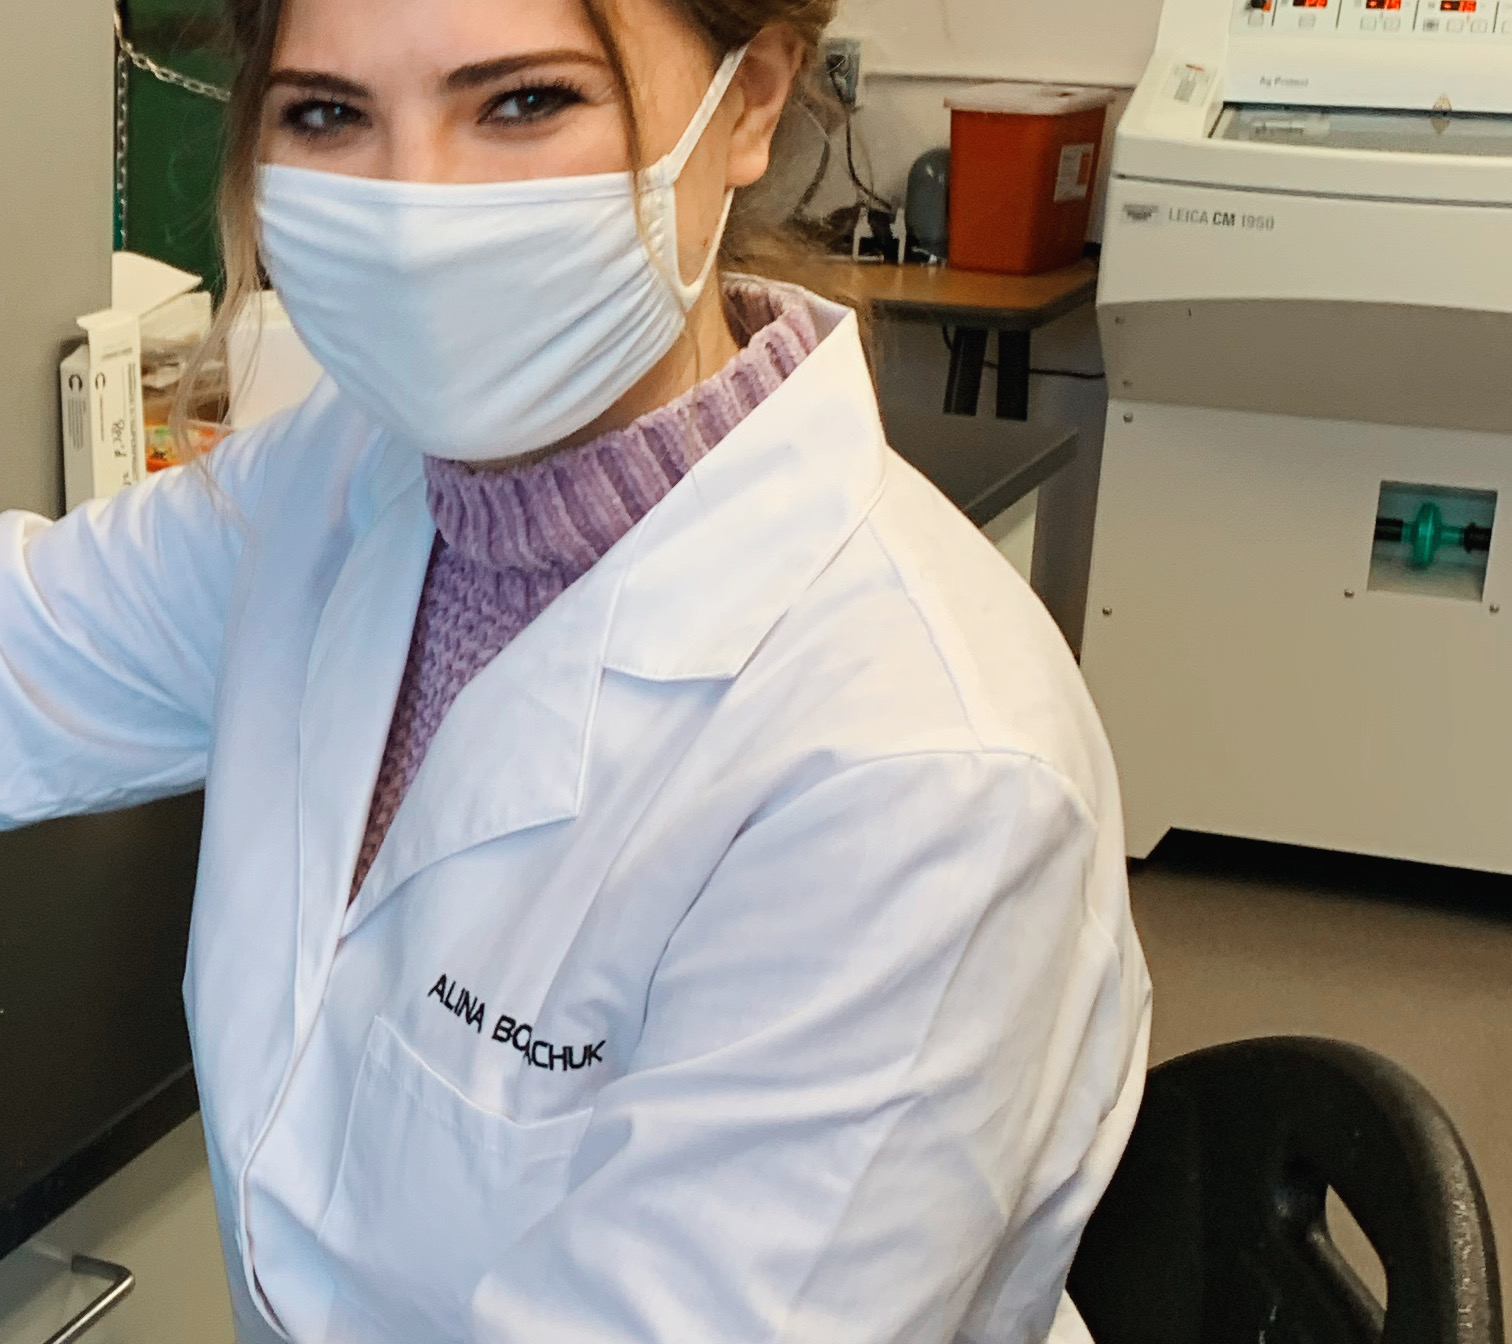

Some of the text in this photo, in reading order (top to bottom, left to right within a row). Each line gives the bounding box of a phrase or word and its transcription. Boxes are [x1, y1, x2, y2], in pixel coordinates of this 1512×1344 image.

[1168, 207, 1209, 225] LEICA
[1213, 211, 1236, 227] CM
[1241, 214, 1276, 231] 1950
[427, 972, 486, 1035] ALINA
